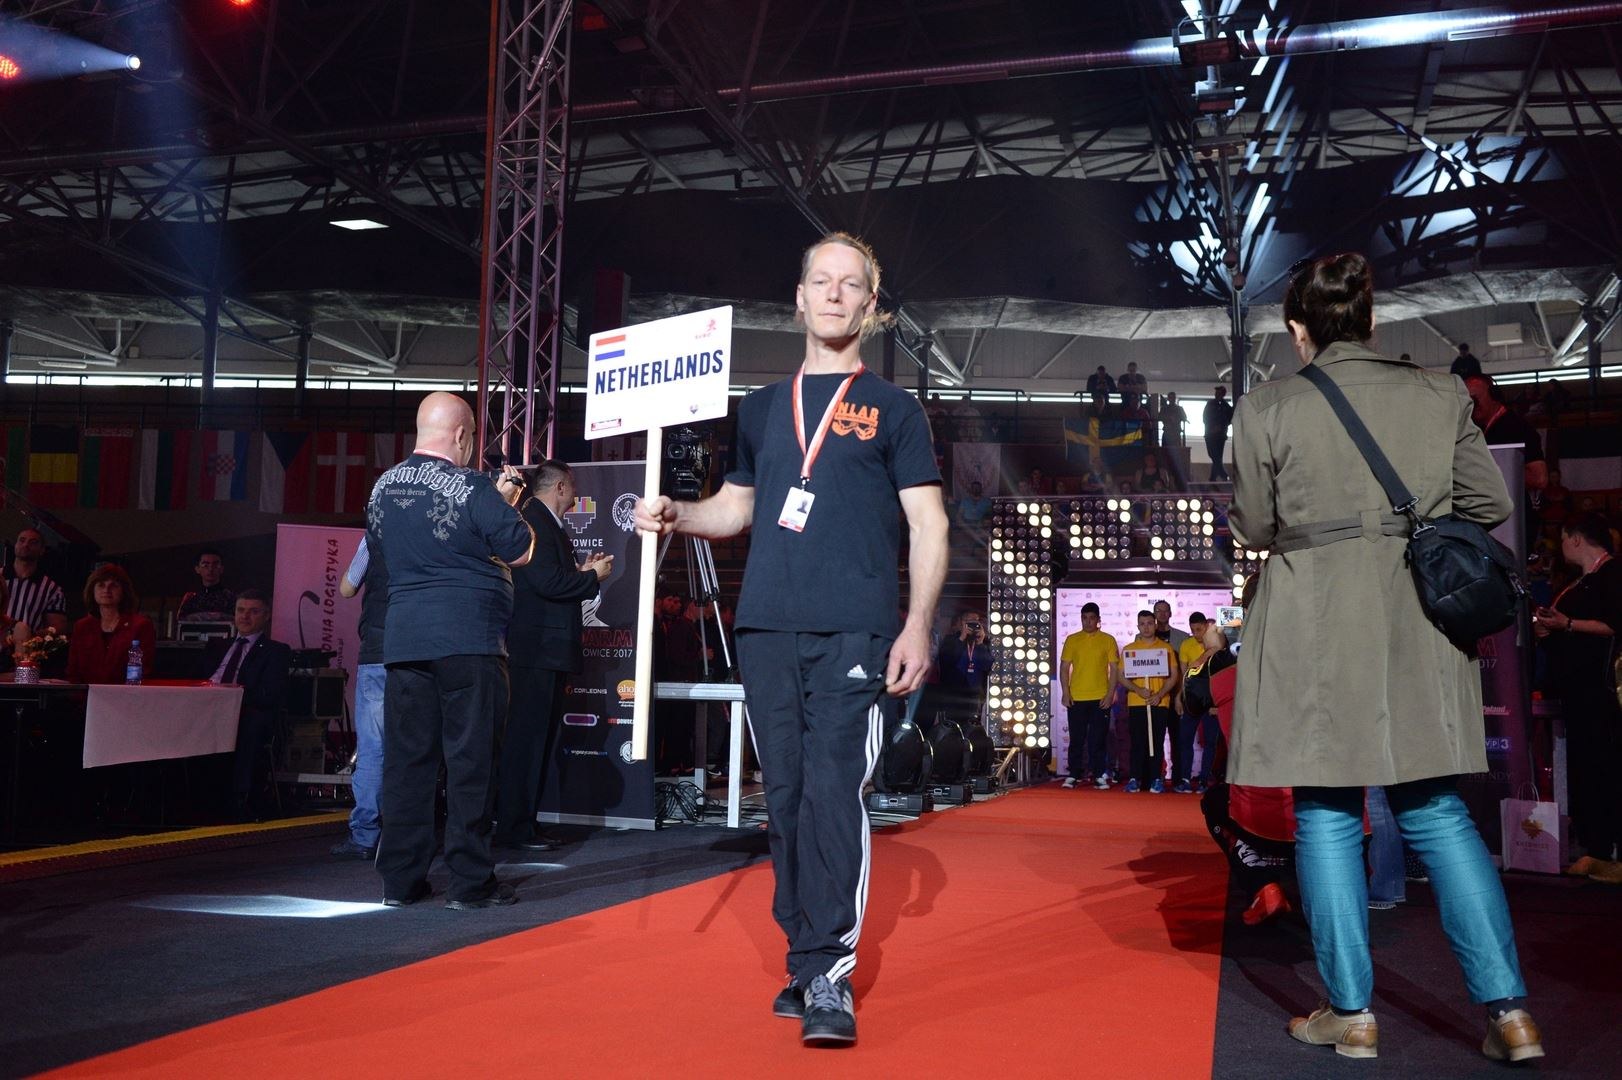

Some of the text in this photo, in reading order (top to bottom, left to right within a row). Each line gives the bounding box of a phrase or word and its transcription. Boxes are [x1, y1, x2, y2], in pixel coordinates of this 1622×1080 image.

[595, 349, 724, 395] NETHERLANDS
[406, 487, 428, 496] Series
[570, 538, 604, 548] OWICE
[323, 538, 339, 616] LOGISTYKA
[613, 648, 633, 658] 2017
[1132, 658, 1161, 668] ROMANIA
